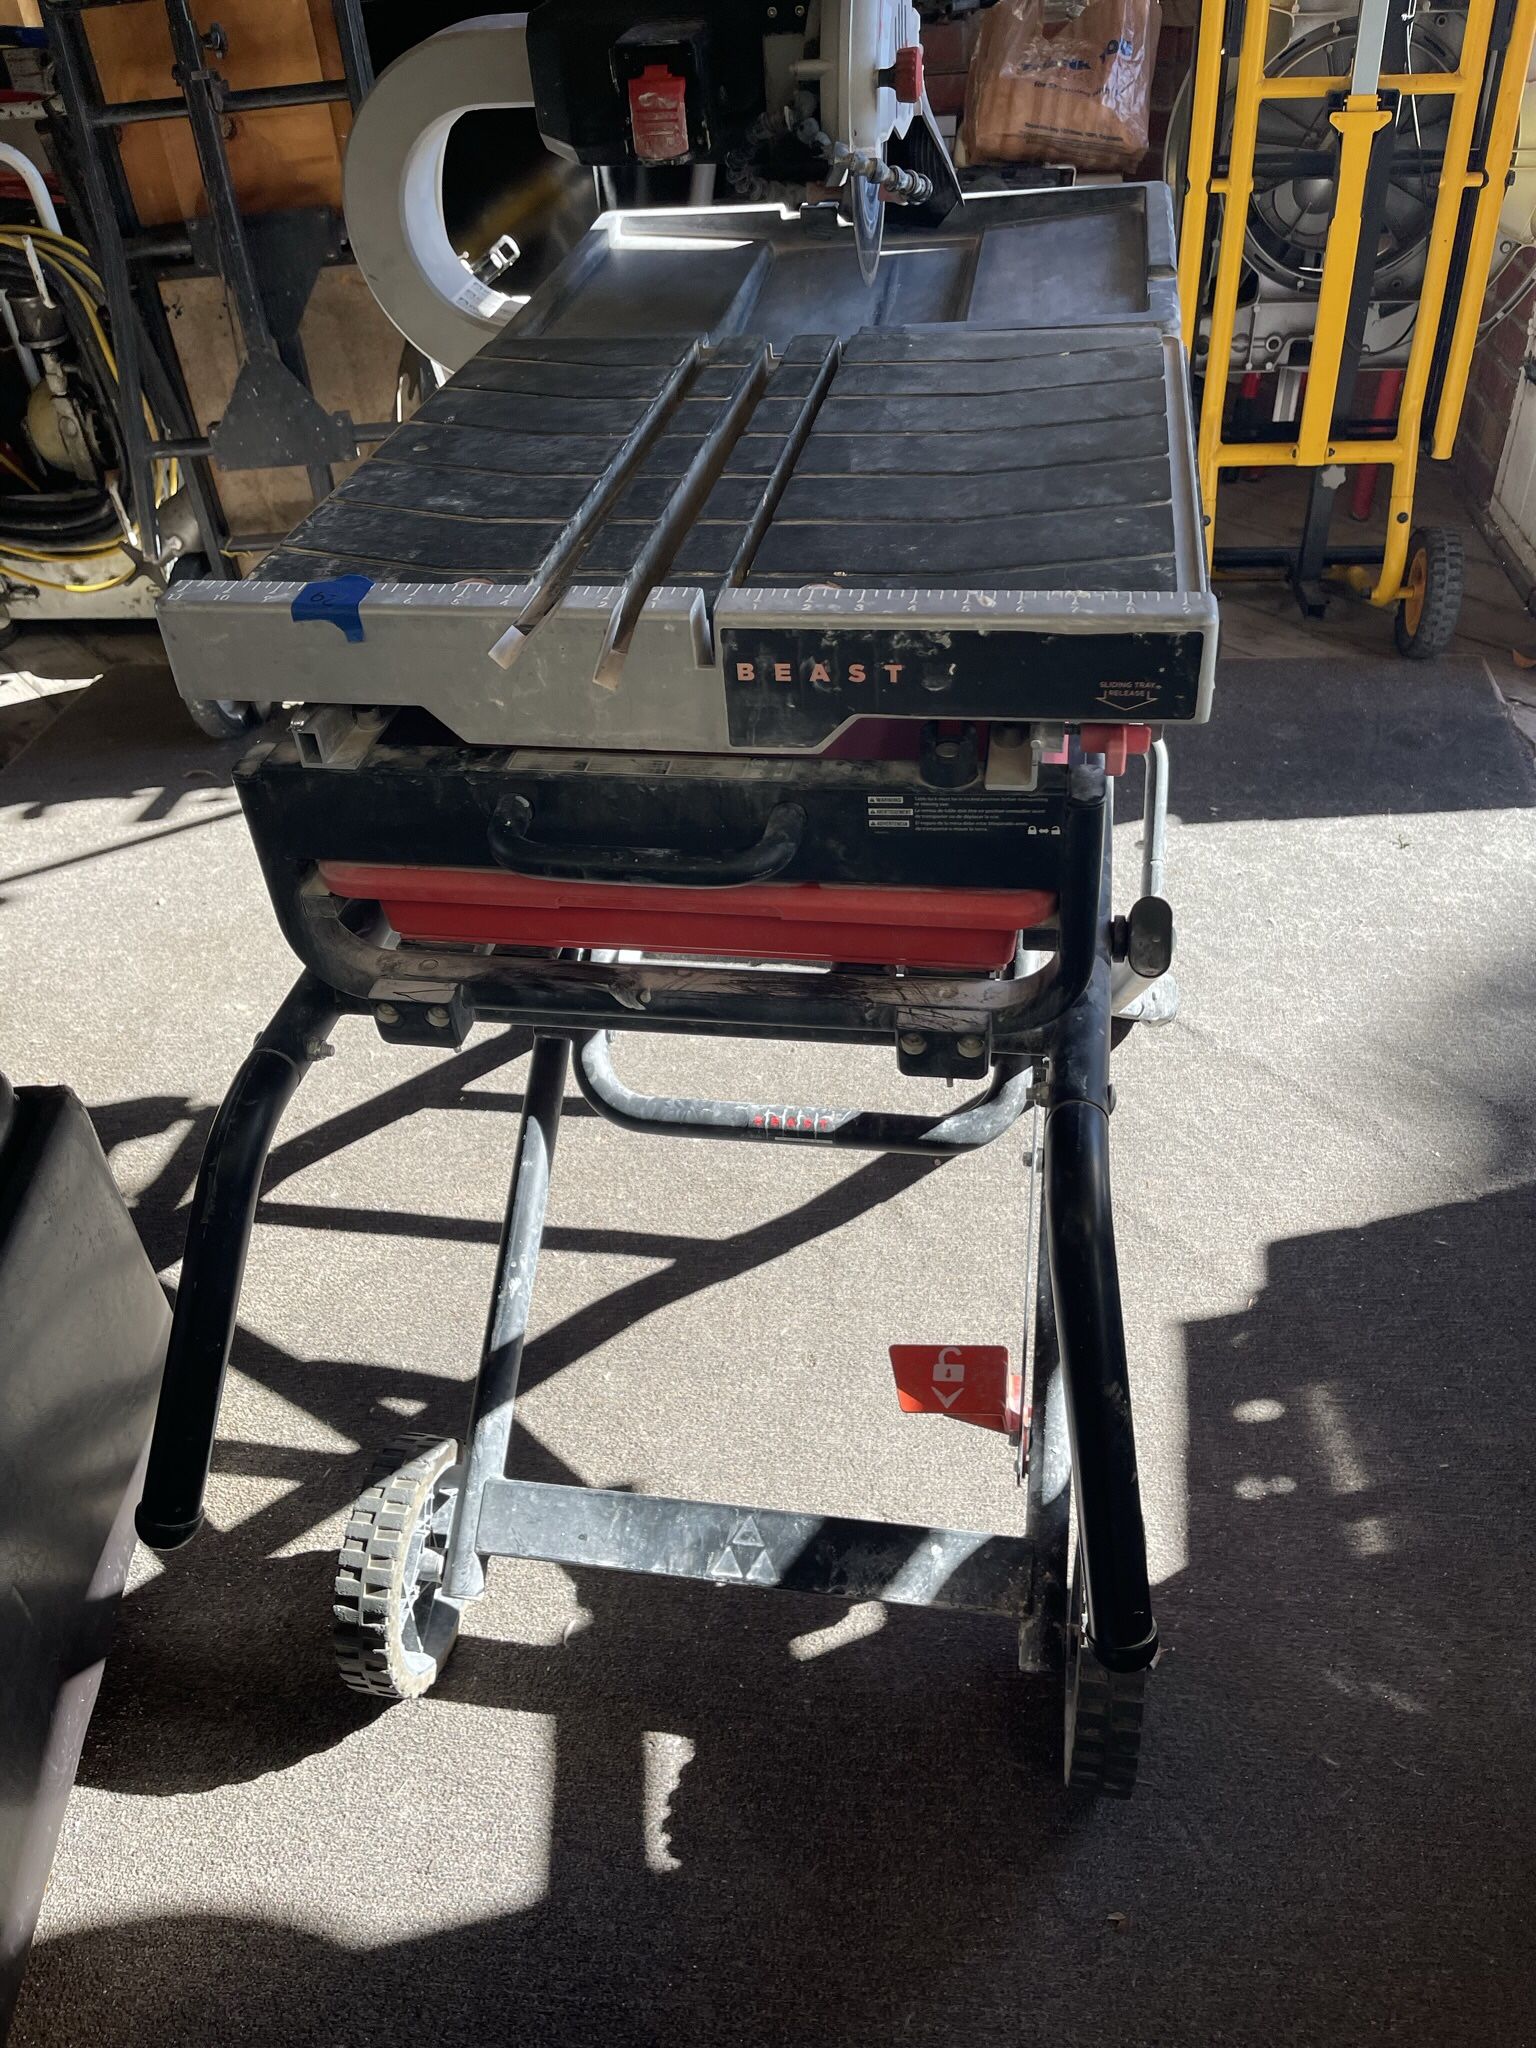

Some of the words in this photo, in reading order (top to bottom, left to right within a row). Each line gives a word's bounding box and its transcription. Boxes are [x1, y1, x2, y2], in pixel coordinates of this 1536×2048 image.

[736, 663, 903, 683] BEAST
[1099, 681, 1133, 689] SLIDING
[1134, 681, 1156, 689] TRAY
[1108, 689, 1145, 697] RELEASE
